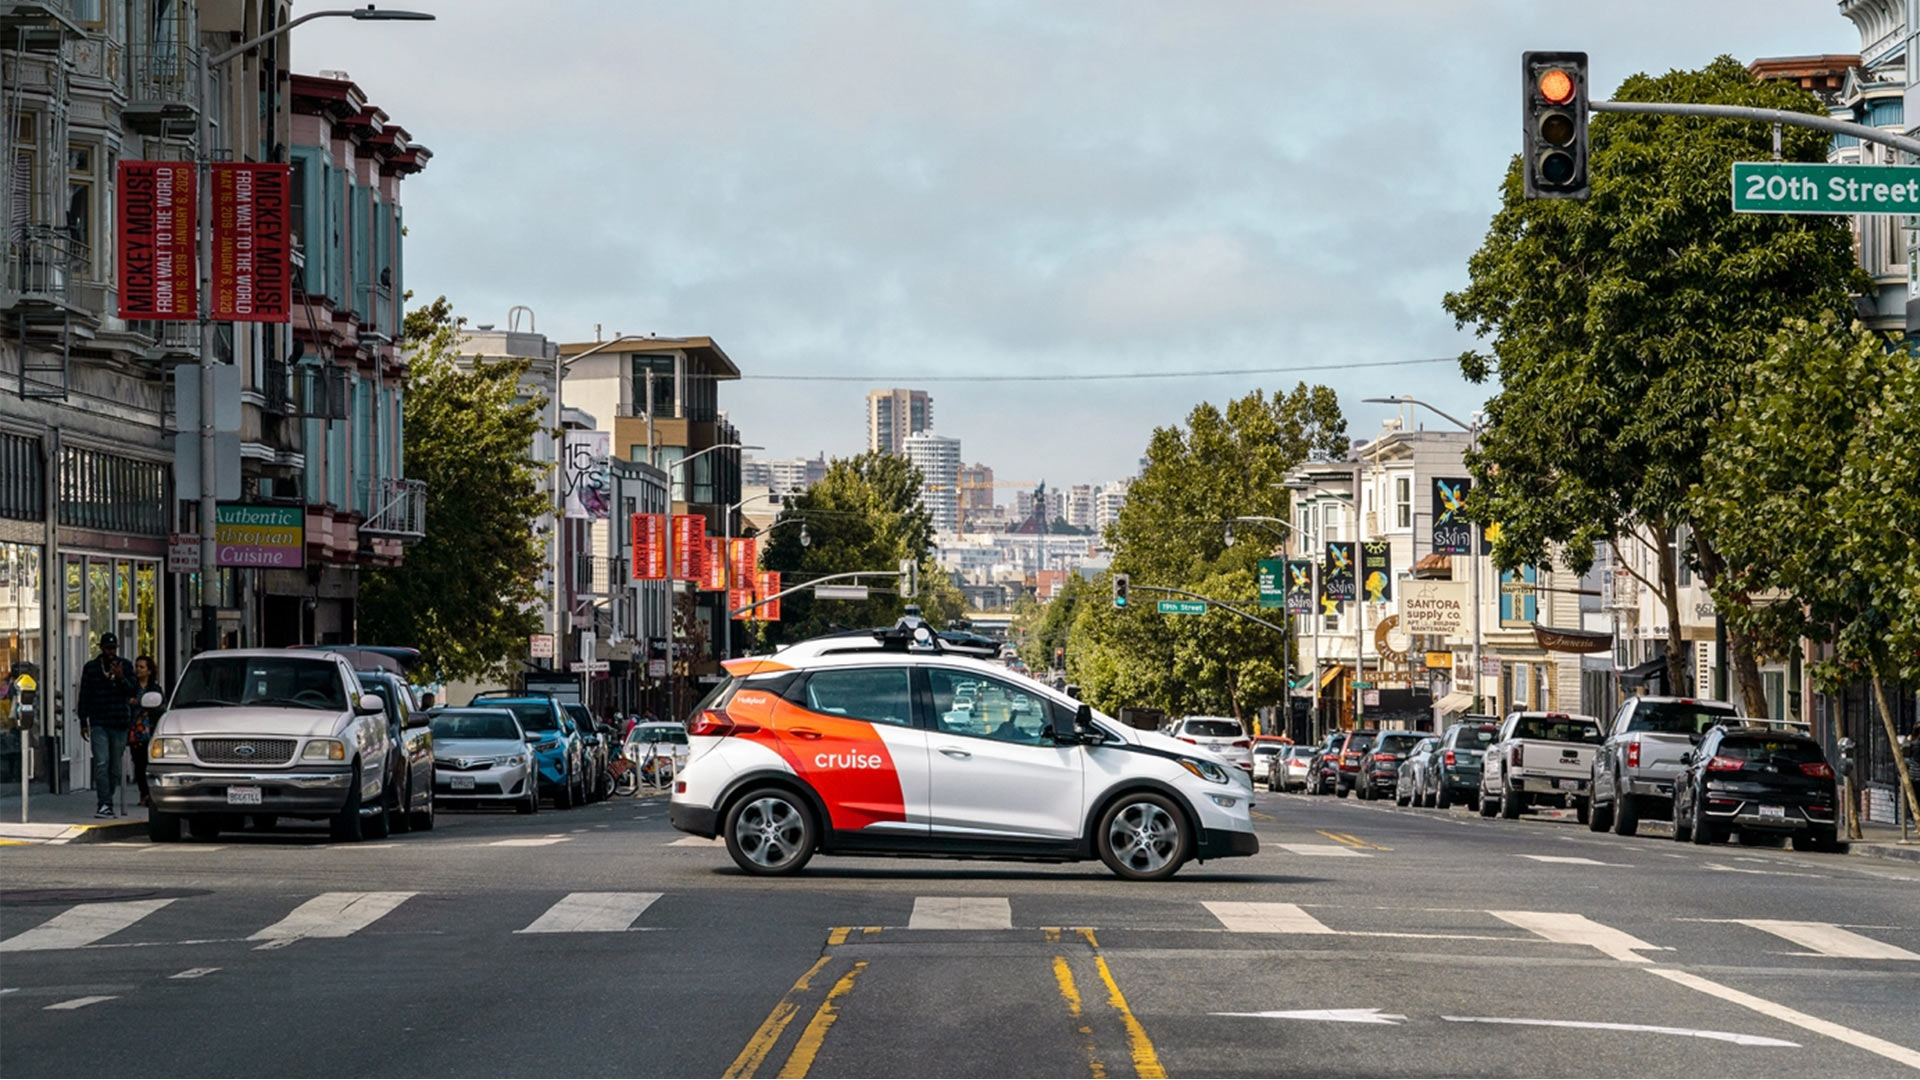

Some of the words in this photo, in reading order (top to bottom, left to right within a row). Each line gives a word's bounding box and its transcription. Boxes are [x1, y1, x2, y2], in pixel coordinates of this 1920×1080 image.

[157, 167, 173, 208] WORLD
[176, 167, 188, 193] 2020
[220, 169, 233, 189] MAY
[236, 170, 252, 202] FROM
[1745, 174, 1818, 201] 20th
[1827, 176, 1919, 202] Street
[126, 167, 153, 235] MOUSE
[256, 171, 281, 242] MICKEY
[157, 209, 173, 231] THE
[176, 206, 188, 246] JANUARY
[220, 206, 232, 228] 2019
[236, 204, 252, 233] WALT
[157, 233, 173, 247] TO
[236, 235, 252, 249] TO
[157, 250, 173, 279] WALT
[176, 254, 188, 276] 2019
[220, 236, 232, 275] JANUARY
[236, 251, 252, 272] THE
[126, 240, 153, 313] MICKEY
[256, 247, 281, 315] MOUSE
[157, 281, 173, 313] FROM
[176, 293, 188, 313] MAY
[220, 288, 232, 314] 2020
[236, 274, 252, 314] WORLD
[565, 443, 591, 470] 15
[565, 470, 604, 497] yrs
[215, 507, 293, 525] Authentic
[216, 528, 293, 545] thiopian
[636, 516, 649, 544] MOUSE
[690, 519, 702, 548] MICKEY
[221, 546, 283, 564] Cuisine
[636, 545, 649, 576] MICKEY
[690, 550, 702, 577] MOUSE
[1406, 599, 1461, 610] SANTORA
[1406, 610, 1443, 620] supply
[737, 696, 766, 705] Hollyleaf
[814, 749, 882, 769] cruise
